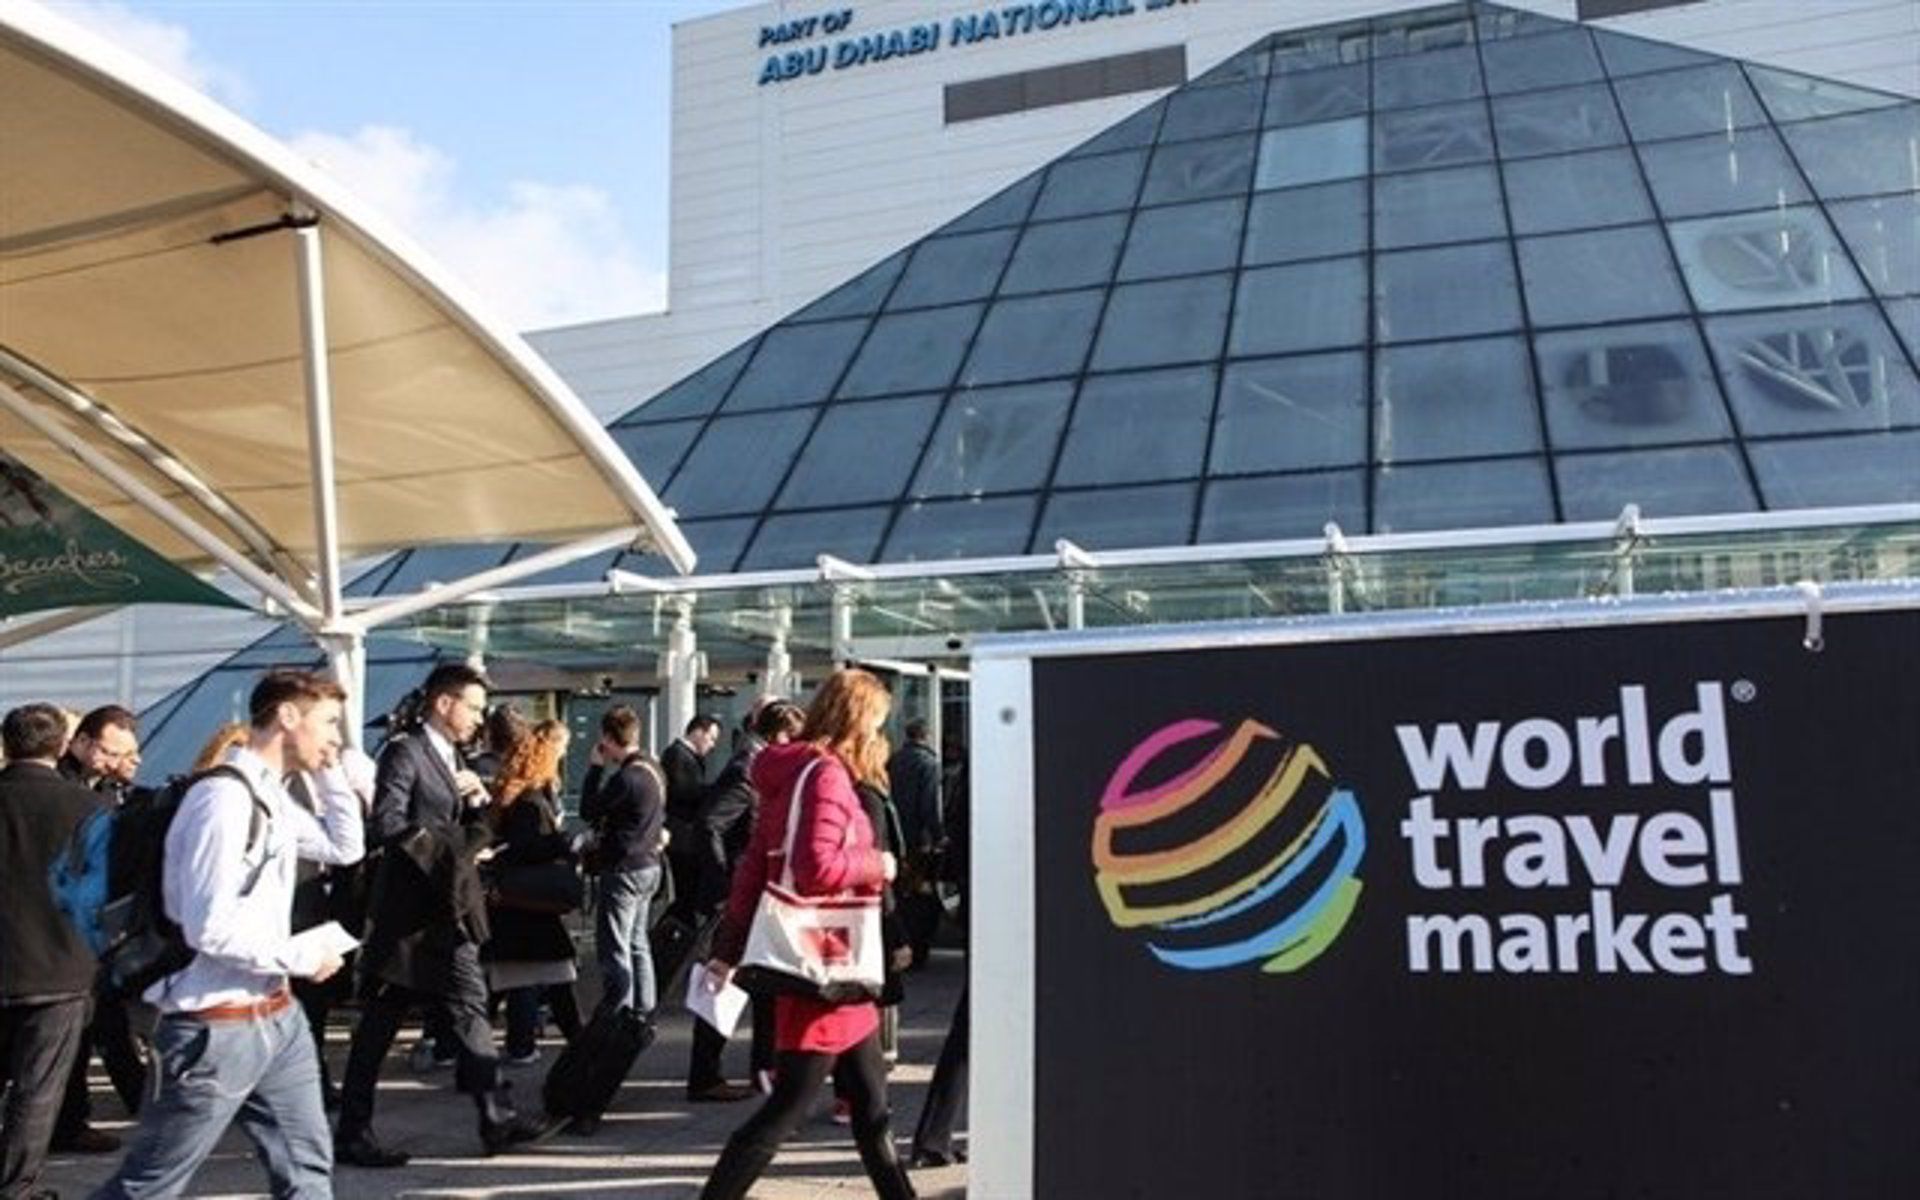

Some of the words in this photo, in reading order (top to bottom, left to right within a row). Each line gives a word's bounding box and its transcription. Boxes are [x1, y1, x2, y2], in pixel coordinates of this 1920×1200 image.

[758, 46, 828, 86] ABU
[832, 23, 940, 70] DHABI
[948, 0, 1135, 47] NATIONAL
[759, 17, 818, 47] PART
[822, 9, 853, 34] OF
[1395, 681, 1732, 790] world
[1401, 789, 1743, 888] travel
[1406, 889, 1753, 975] market
